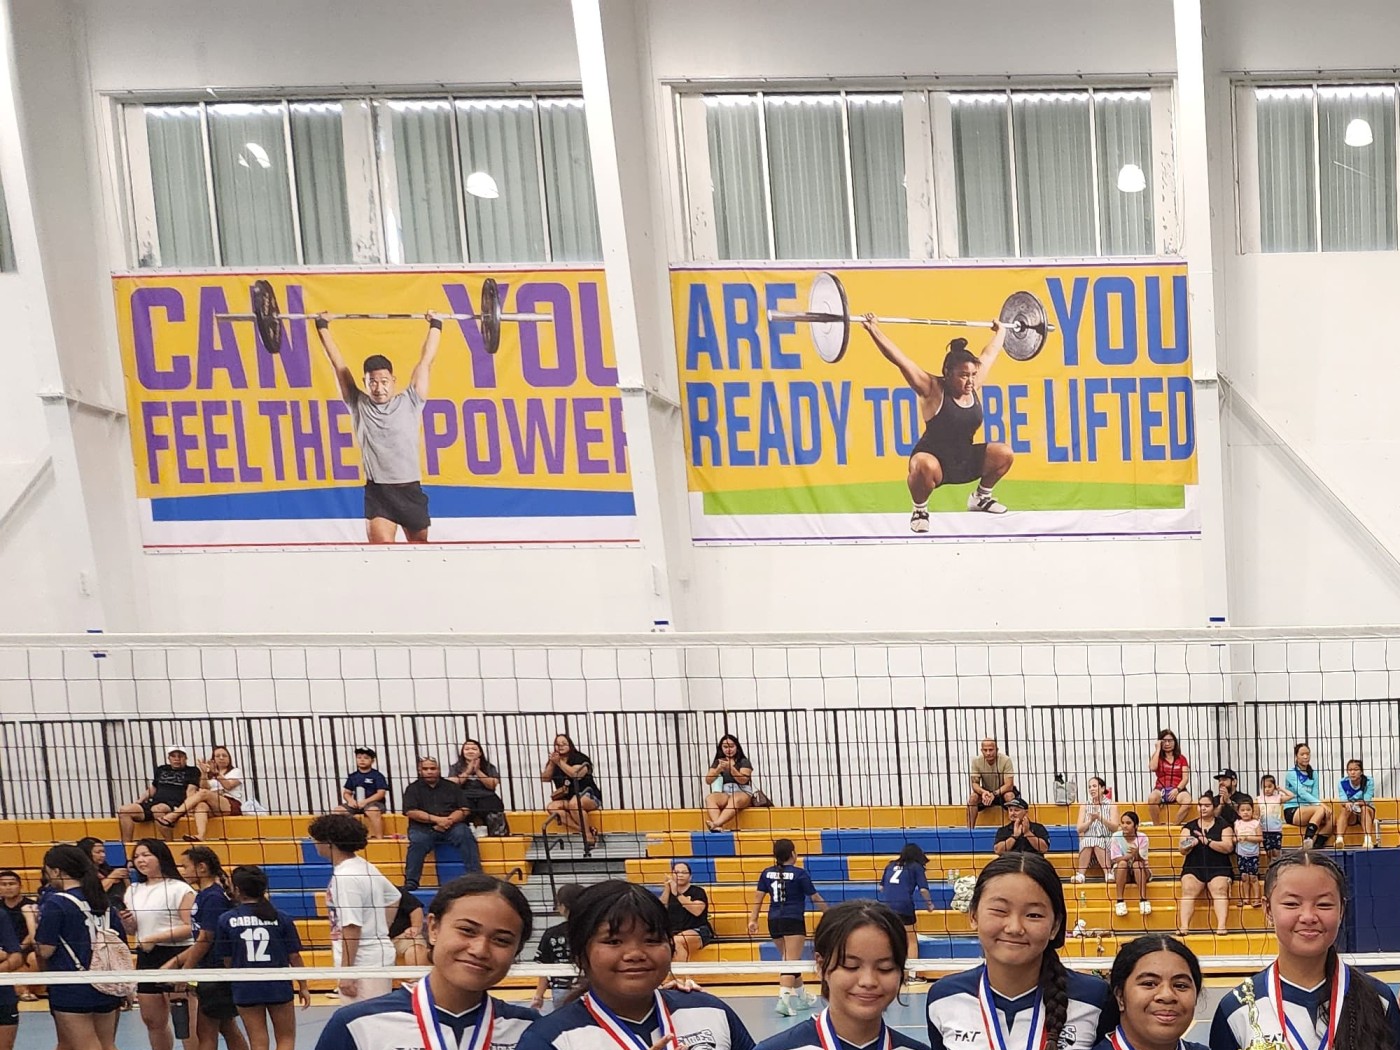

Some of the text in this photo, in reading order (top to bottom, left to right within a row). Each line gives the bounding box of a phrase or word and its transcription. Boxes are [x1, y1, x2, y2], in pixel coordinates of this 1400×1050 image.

[130, 284, 312, 390] CAN
[685, 274, 1192, 371] ARE YOU
[143, 400, 263, 485] FEEL
[258, 399, 360, 483] THE
[685, 375, 1197, 467] READY TO BE LIFTED
[889, 865, 903, 884] 2
[240, 927, 271, 962] 12
[954, 1030, 981, 1042] FAT
